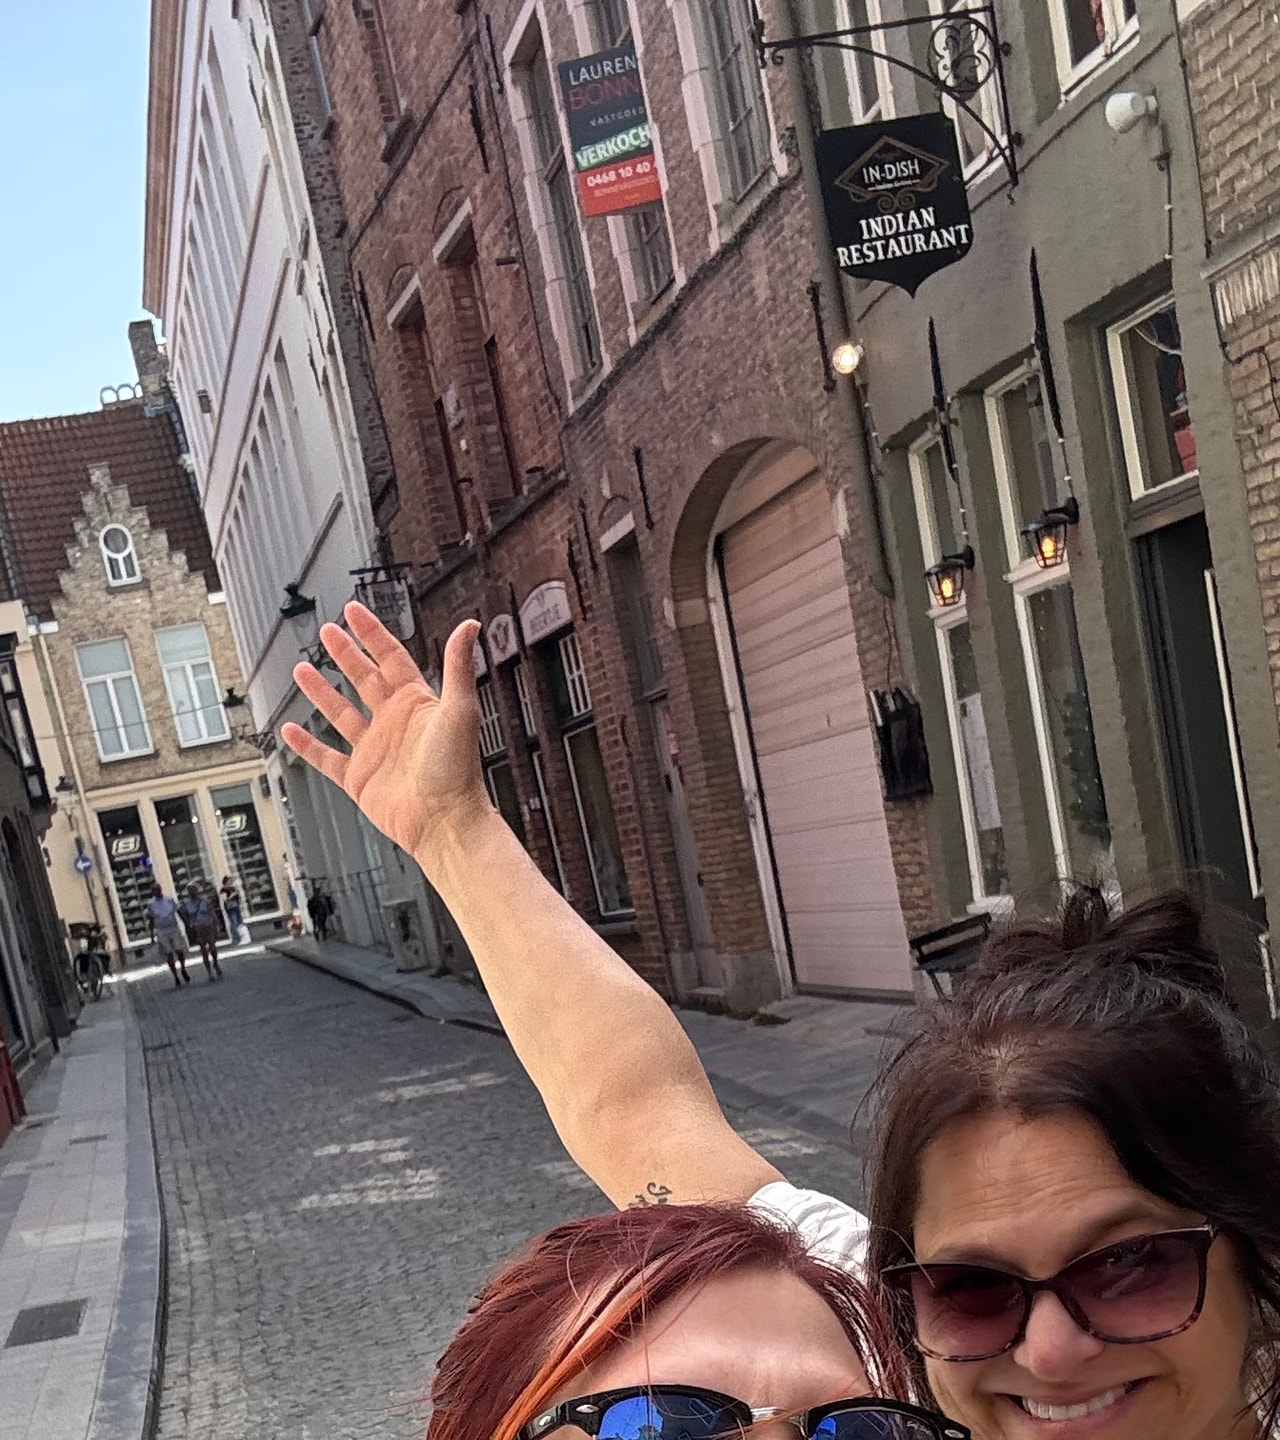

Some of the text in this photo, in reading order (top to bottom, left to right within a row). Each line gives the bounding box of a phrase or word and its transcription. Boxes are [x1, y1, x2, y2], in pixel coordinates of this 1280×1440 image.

[569, 56, 637, 86] LAUREN
[862, 158, 921, 184] IN-DISH
[859, 206, 936, 240] INDIAN
[836, 224, 969, 267] RESTAURANT
